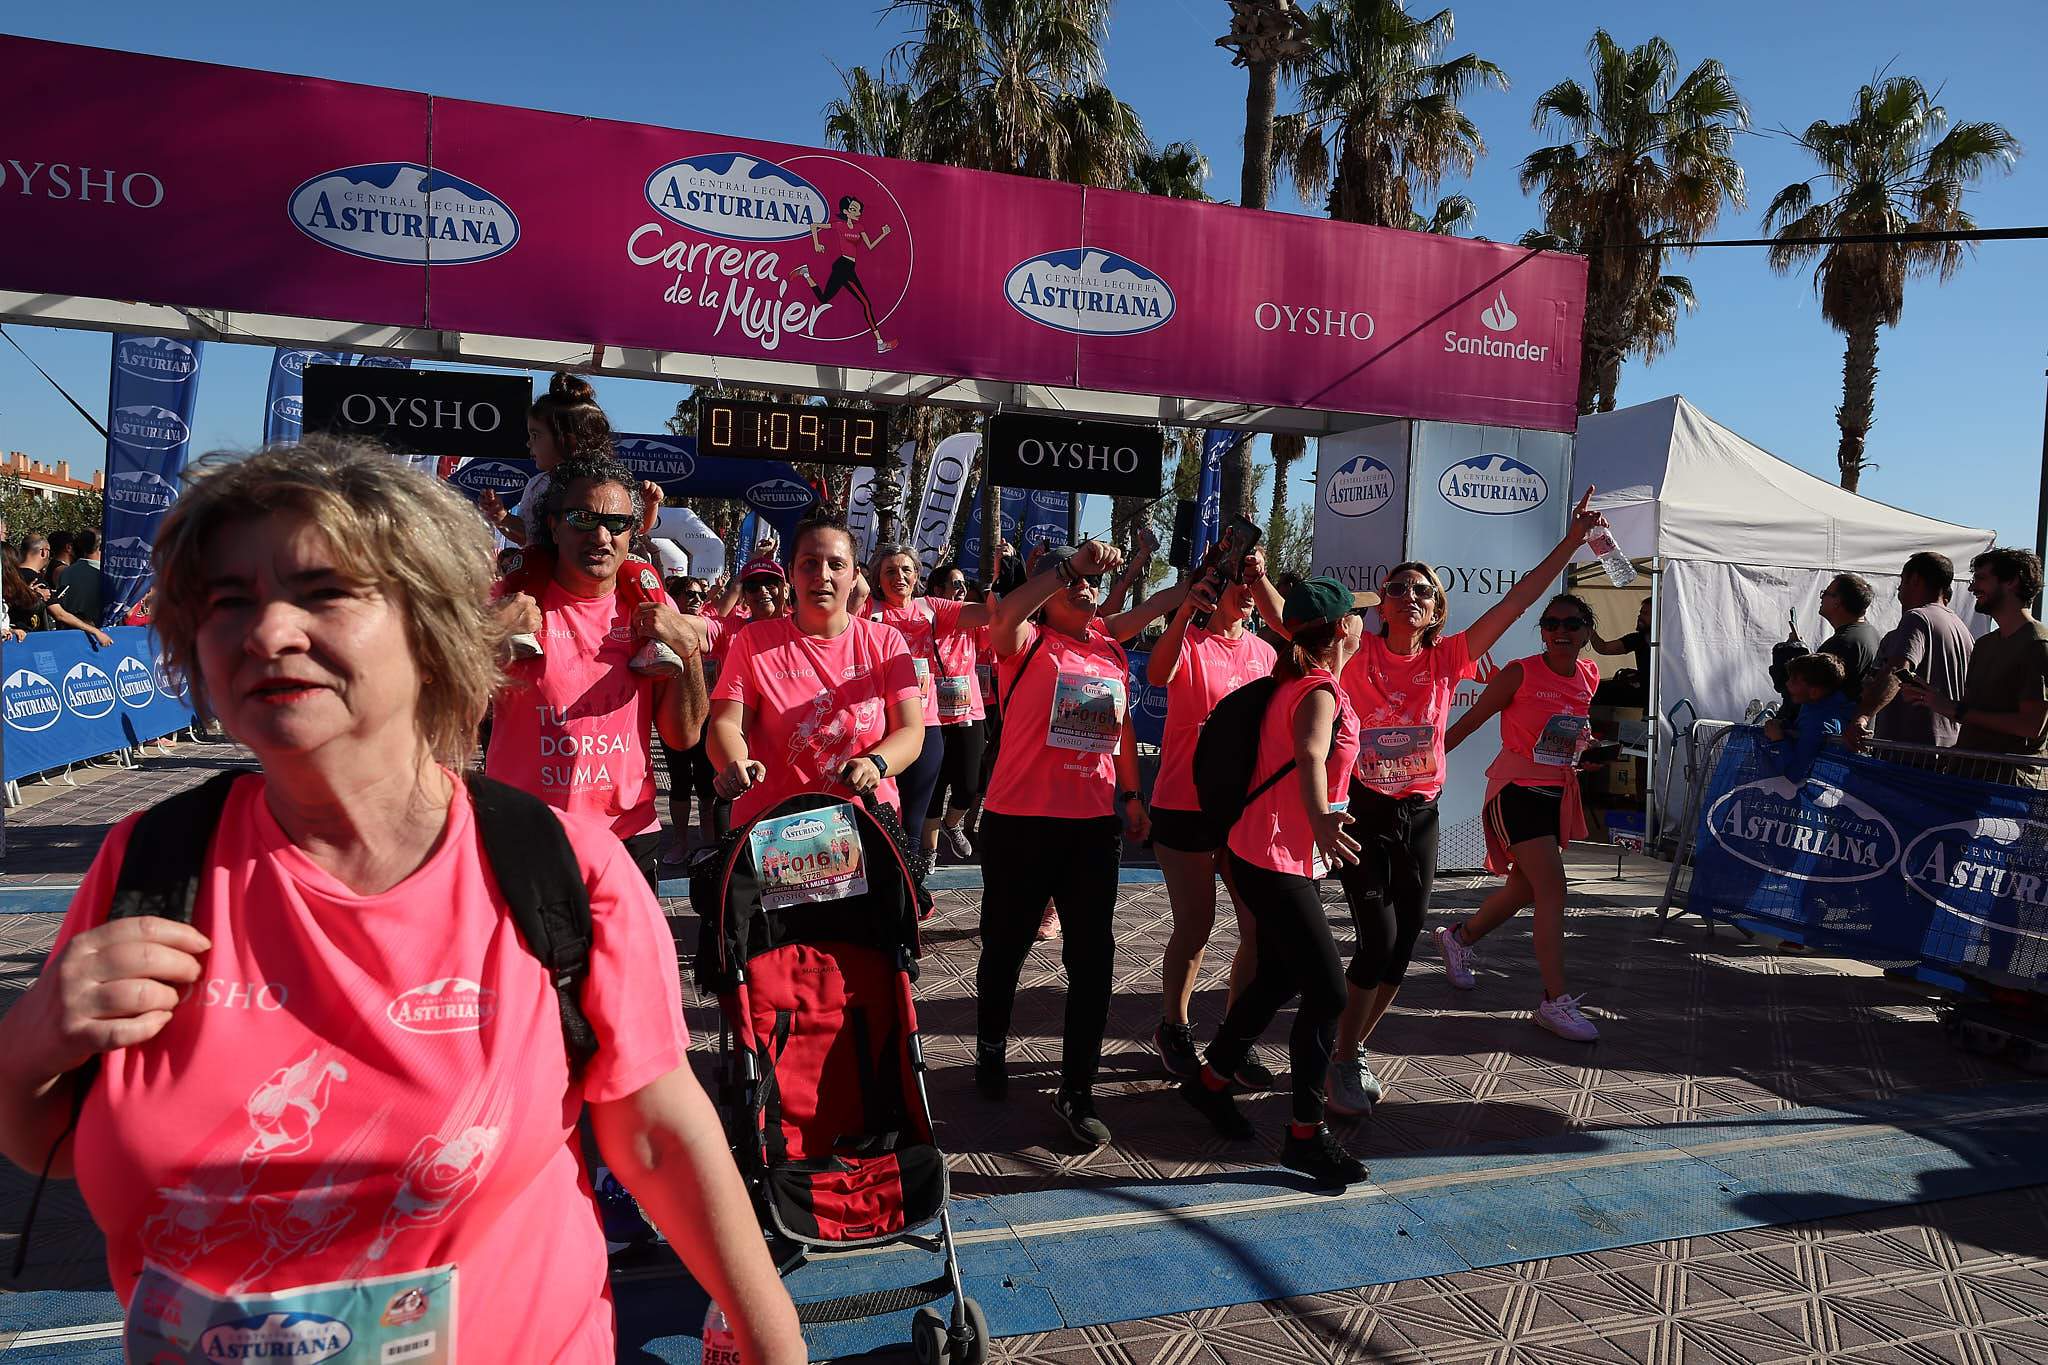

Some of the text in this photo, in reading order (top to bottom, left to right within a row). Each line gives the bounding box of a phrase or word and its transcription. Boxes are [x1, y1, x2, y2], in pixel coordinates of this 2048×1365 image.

[0, 160, 164, 208] YSHO
[690, 177, 811, 200] CENTRAL LECHERA
[344, 191, 417, 208] CENTRAL
[659, 175, 814, 225] ASTURIANA
[306, 191, 502, 246] ASTURIANA
[627, 223, 779, 282] Carrera
[1018, 272, 1162, 318] ASTURIANA
[1045, 273, 1159, 293] CENTRAL LECHERA
[663, 274, 833, 350] de la Mujer
[1254, 302, 1375, 341] OYSHO
[1444, 330, 1549, 362] Santander
[341, 393, 501, 432] OYSHO
[617, 458, 688, 475] TURIANA
[1017, 438, 1139, 474] OYSHO
[462, 471, 525, 487] ASTURIANA
[1446, 473, 1540, 502] ASTURIANA
[1464, 472, 1537, 485] CENTRAL LECHERA
[751, 489, 809, 504] ASTURIANA
[1034, 491, 1069, 508] ASTURIA
[1330, 482, 1389, 504] ASTURIANA
[1322, 564, 1389, 591] OYSHO
[1435, 565, 1533, 595] OYSH
[775, 667, 814, 680] OYSHO
[68, 684, 114, 708] ASTURIANA
[119, 678, 153, 699] ASTURIANA
[5, 694, 59, 720] ASTURIANA
[536, 705, 567, 727] TU
[541, 763, 611, 787] SUMA
[785, 825, 824, 839] ASTURIANA
[1719, 799, 1880, 868] ASTURIANA
[791, 852, 831, 872] 016
[180, 978, 289, 1011] SHO
[207, 1334, 341, 1359] ASTURIANA
